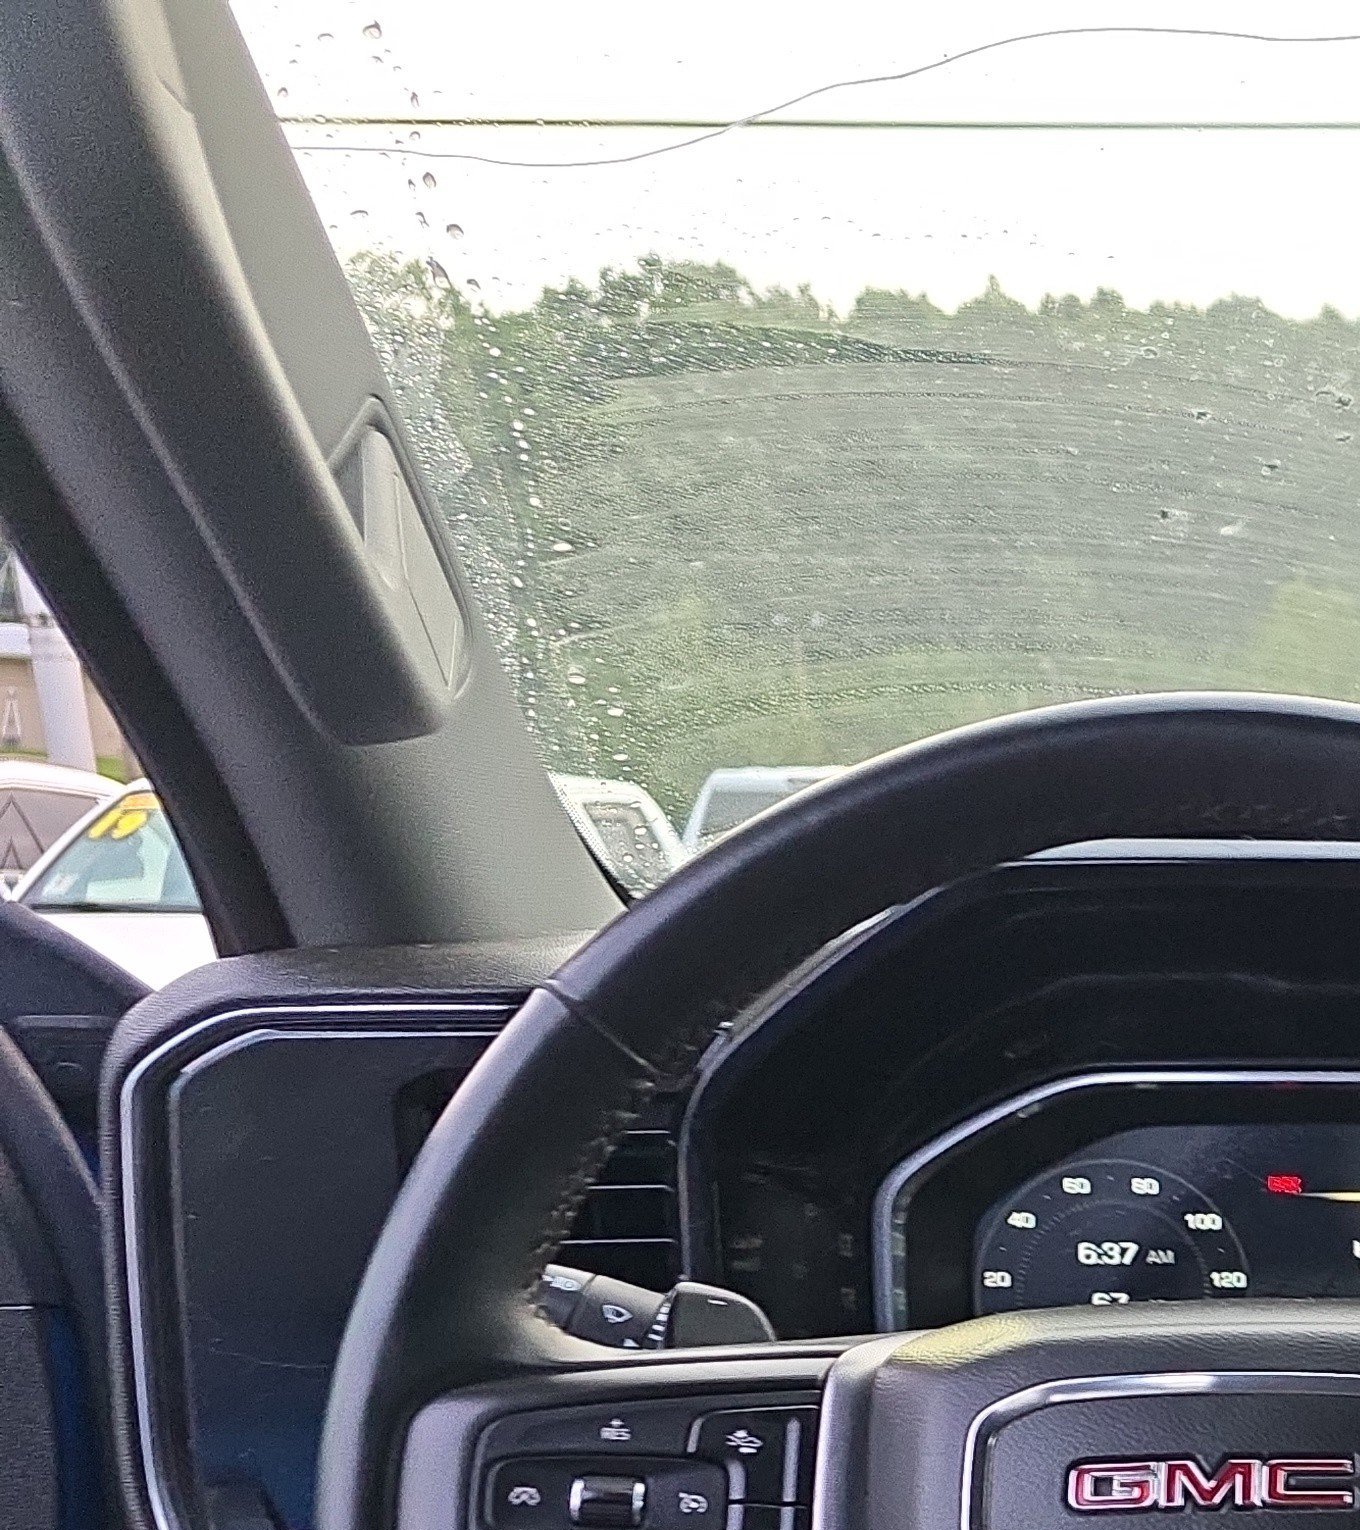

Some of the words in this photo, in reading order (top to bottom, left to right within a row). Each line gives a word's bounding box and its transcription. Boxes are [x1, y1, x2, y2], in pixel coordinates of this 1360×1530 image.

[1183, 1213, 1223, 1231] 100
[983, 1271, 1012, 1288] 20
[1210, 1271, 1247, 1289] 120
[1067, 1458, 1355, 1511] GMC
